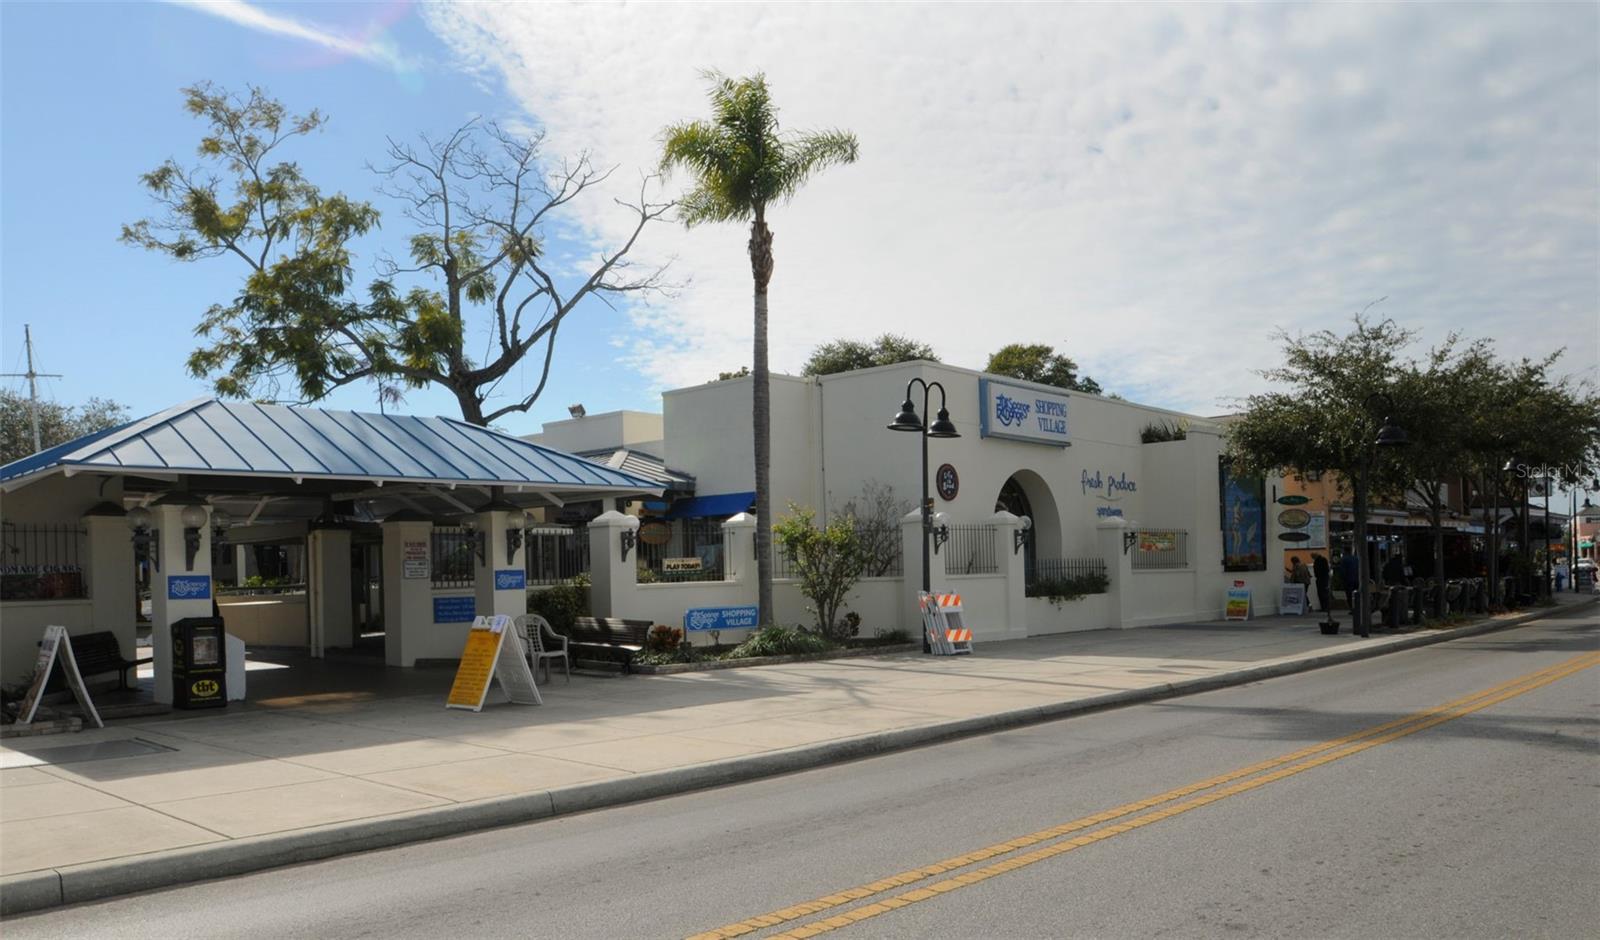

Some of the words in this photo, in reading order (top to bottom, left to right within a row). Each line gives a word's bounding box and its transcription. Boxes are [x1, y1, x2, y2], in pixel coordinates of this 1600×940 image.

[1035, 399, 1067, 418] SHOPPING
[1037, 417, 1067, 434] VILLAGE
[1081, 469, 1104, 496] fresh
[1107, 472, 1137, 496] produce
[721, 609, 757, 618] SHOPPING
[725, 617, 753, 626] VILLAGE
[195, 681, 215, 692] tbt
